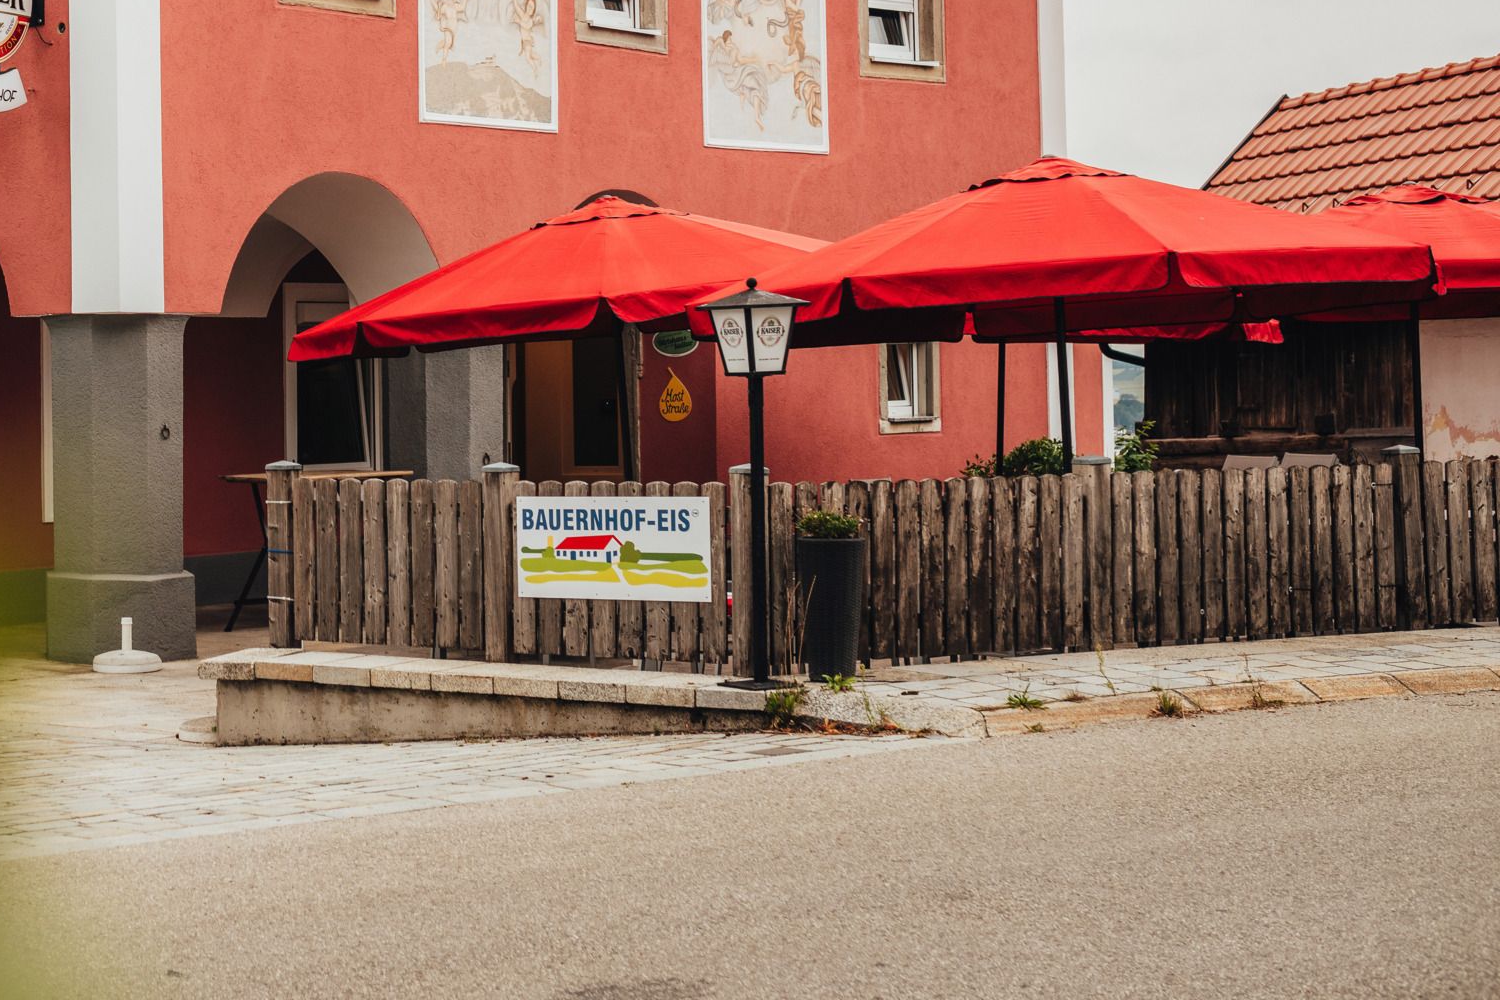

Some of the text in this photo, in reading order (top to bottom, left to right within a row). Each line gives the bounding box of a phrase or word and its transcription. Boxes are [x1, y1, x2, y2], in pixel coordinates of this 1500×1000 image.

[723, 327, 740, 336] KAISER
[760, 326, 781, 335] KAISER
[522, 508, 691, 532] BAUERNHOF-EIS
